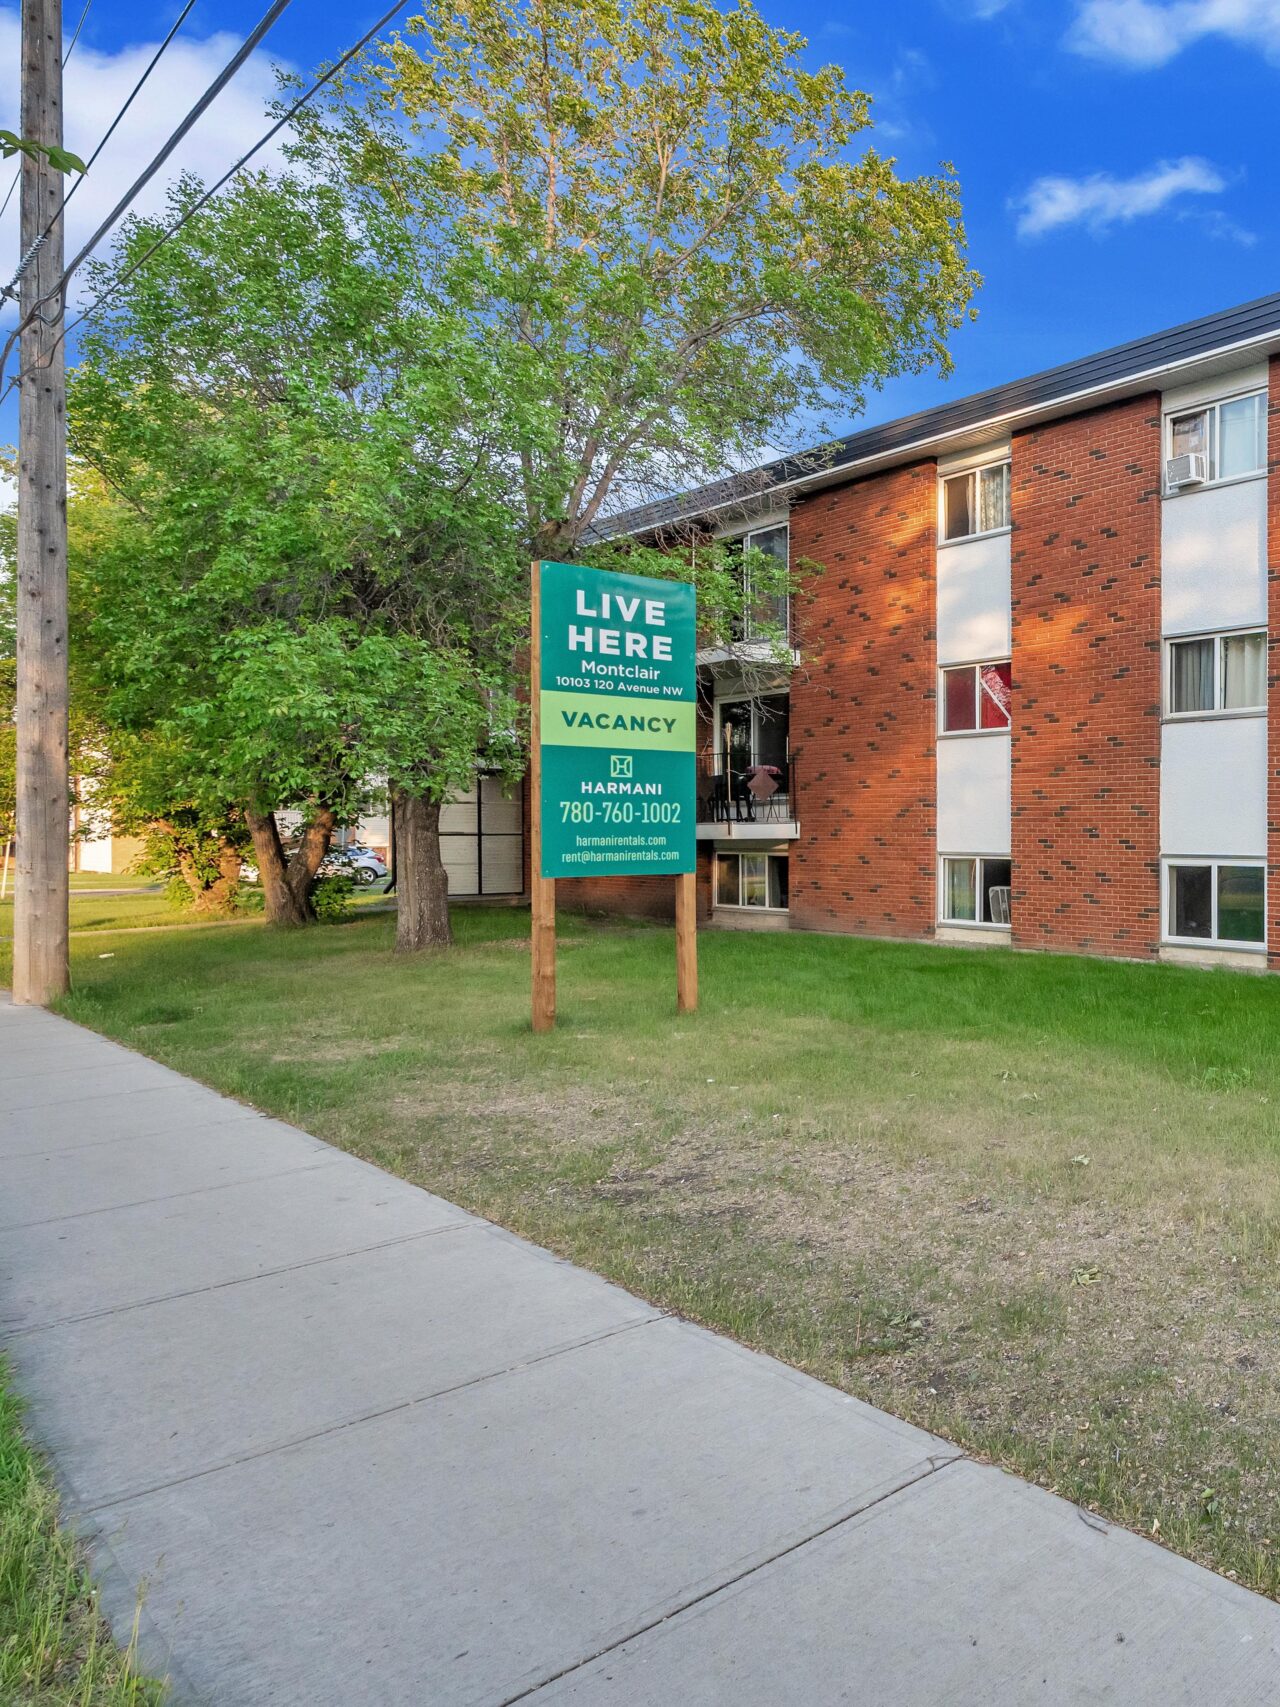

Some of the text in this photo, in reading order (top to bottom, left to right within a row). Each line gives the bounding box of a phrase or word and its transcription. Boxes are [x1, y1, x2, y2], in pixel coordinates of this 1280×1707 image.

[577, 590, 665, 626] LIVE
[569, 625, 672, 661] HERE
[581, 660, 660, 680] Montclair
[556, 676, 683, 696] 10103 120 Avenue NW
[561, 710, 677, 733] VACANCY
[581, 781, 662, 795] HARMANI
[560, 801, 681, 823] 780-760-1002
[576, 835, 666, 846] harmanirentals.com
[562, 850, 679, 863] rent@harmanirentals.com
